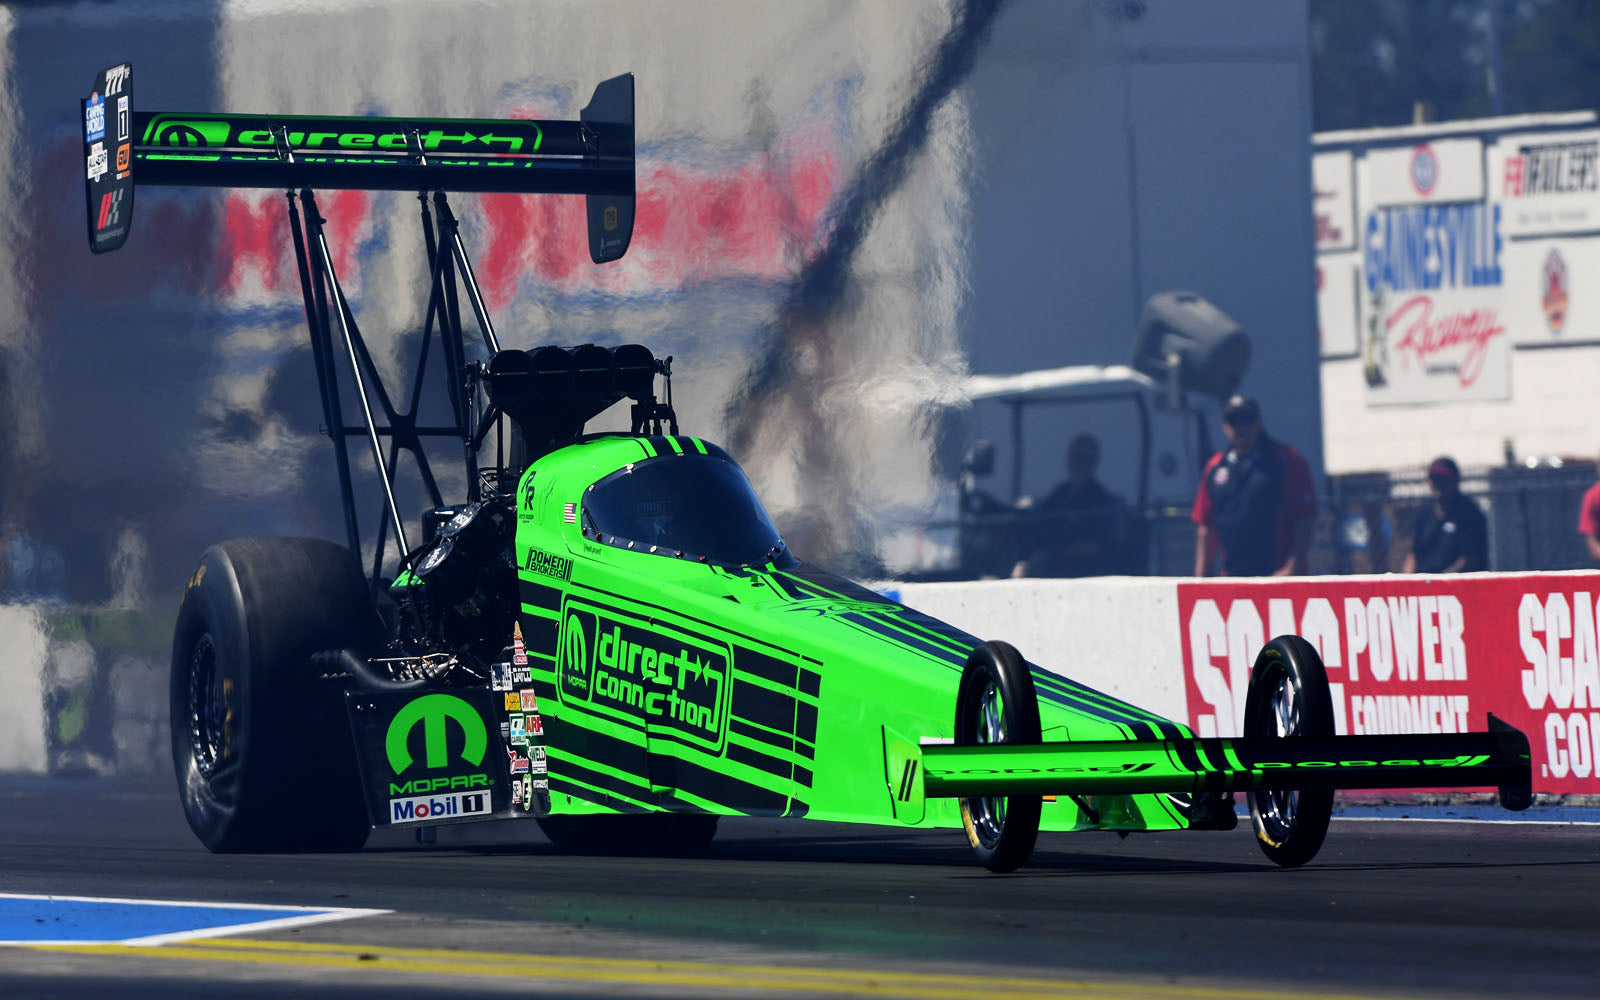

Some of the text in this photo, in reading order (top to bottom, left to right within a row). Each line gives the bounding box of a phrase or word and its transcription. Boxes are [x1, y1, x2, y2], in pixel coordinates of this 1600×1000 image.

[105, 64, 125, 98] 777
[1366, 203, 1503, 293] GAINESVILLE
[531, 561, 564, 581] BROKERS
[1344, 595, 1468, 682] POWER
[1518, 591, 1600, 709] SCA
[567, 675, 587, 691] MOPAR
[526, 717, 542, 732] ARP
[389, 773, 488, 796] MOPAR
[393, 796, 458, 820] Mobil
